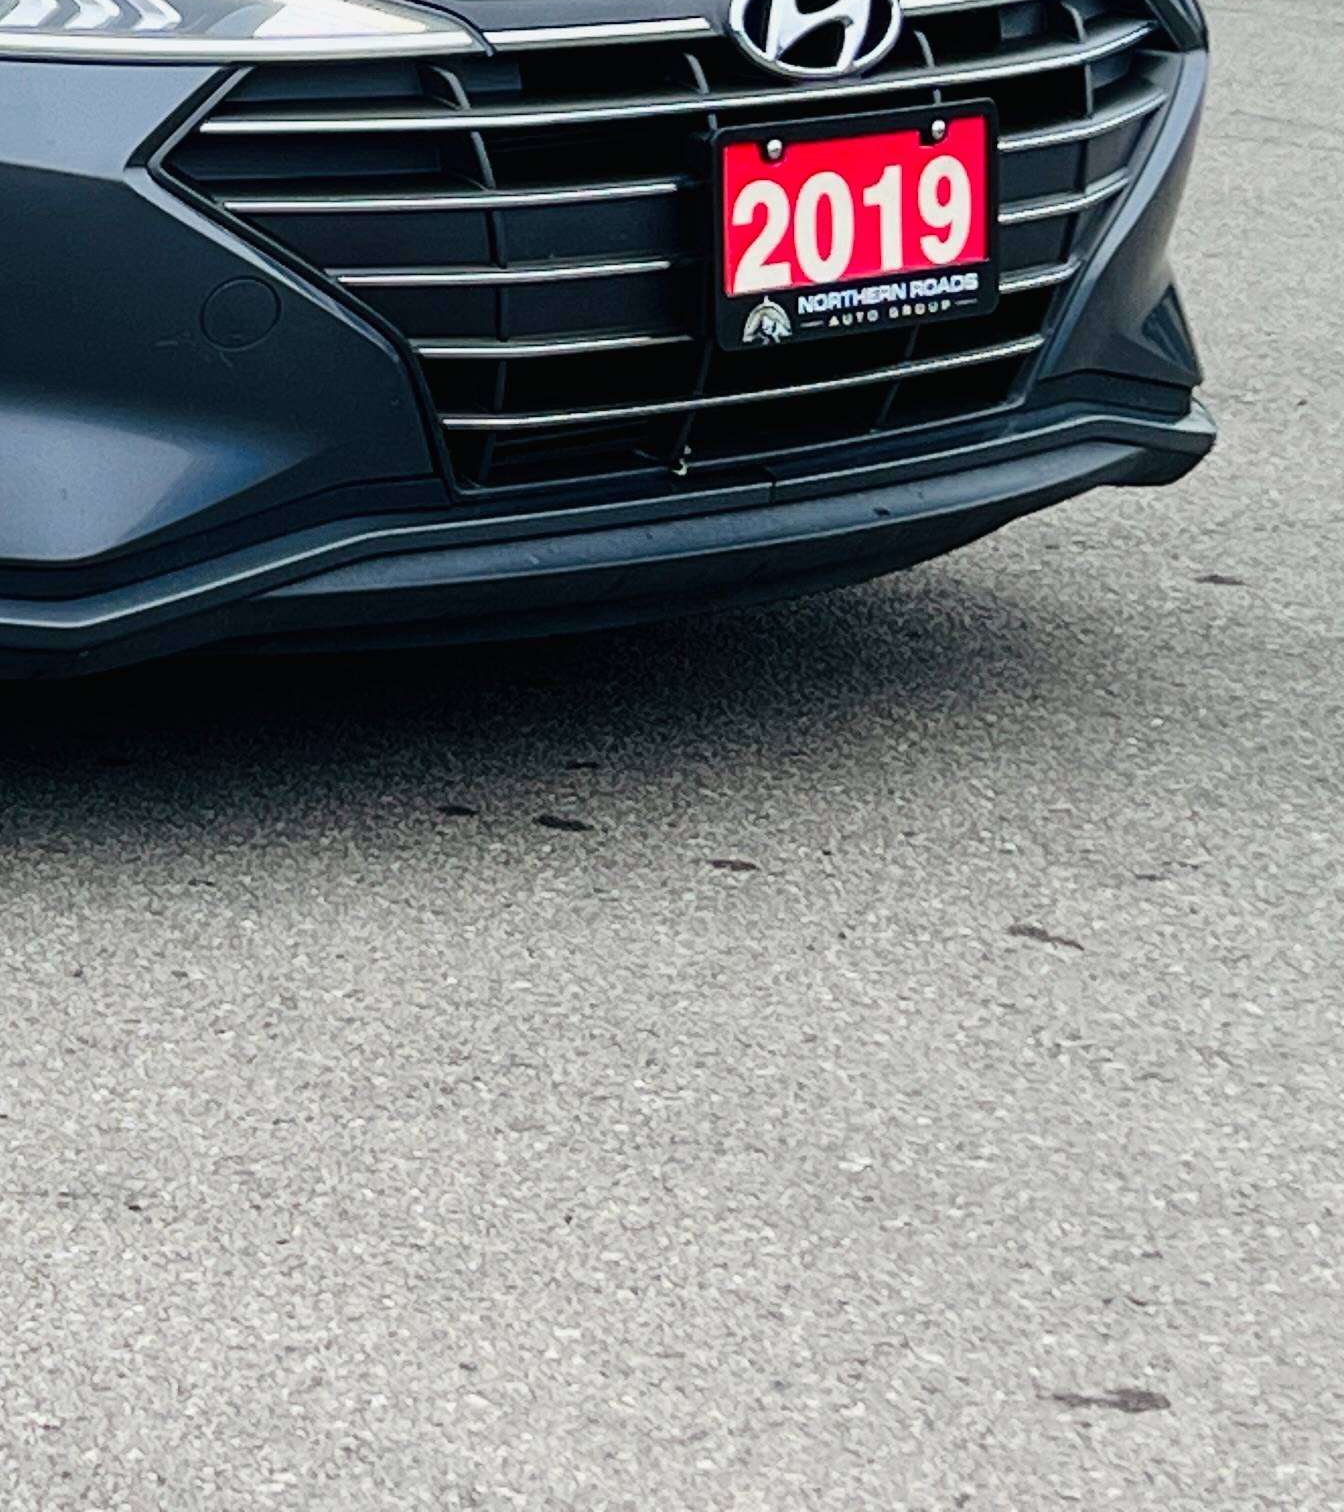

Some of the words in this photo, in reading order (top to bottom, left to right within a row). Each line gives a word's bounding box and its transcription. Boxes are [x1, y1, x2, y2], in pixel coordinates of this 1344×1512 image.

[731, 154, 972, 296] 2019
[798, 283, 907, 315] NORTHERN
[909, 273, 980, 299] ROADS
[828, 309, 879, 327] AUTO
